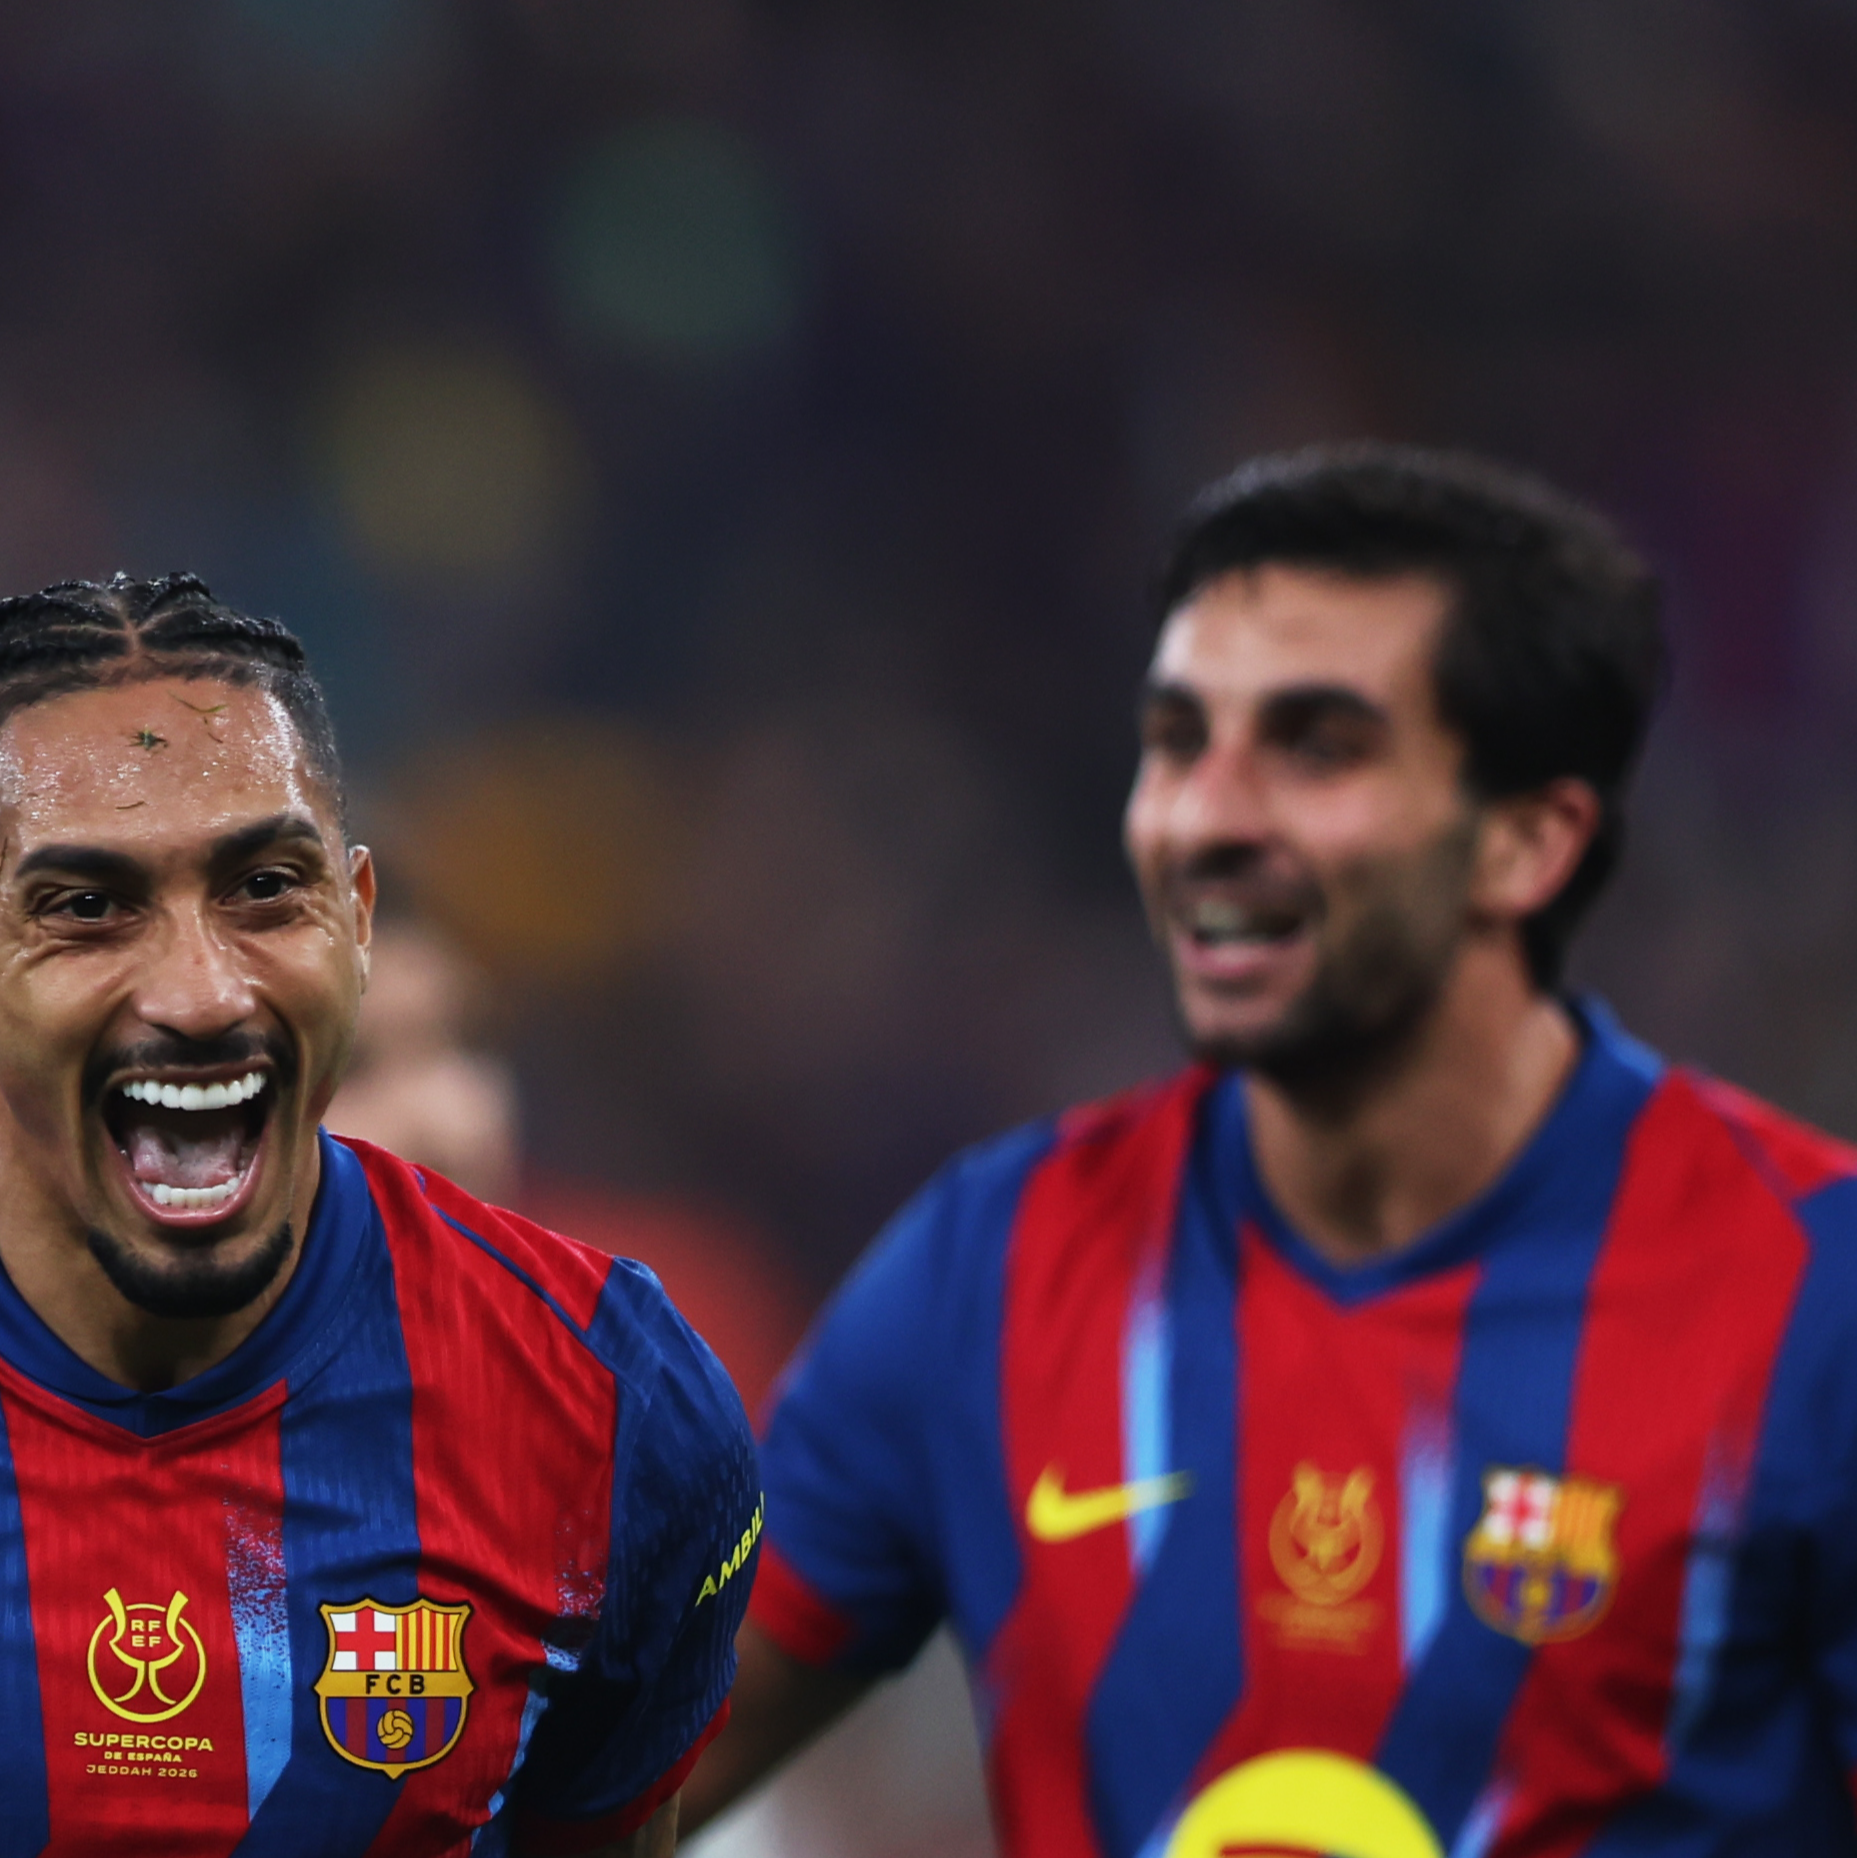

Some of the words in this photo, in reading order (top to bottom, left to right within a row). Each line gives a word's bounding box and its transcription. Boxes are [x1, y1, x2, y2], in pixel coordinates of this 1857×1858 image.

[130, 1619, 161, 1632] RF
[131, 1635, 162, 1648] EF
[365, 1673, 425, 1695] FCB
[73, 1731, 214, 1752] SUPERCOPA
[104, 1751, 123, 1760] DE
[127, 1752, 182, 1763] ESPAÑA
[86, 1764, 152, 1776] JEDDAH
[157, 1767, 198, 1779] 2026
